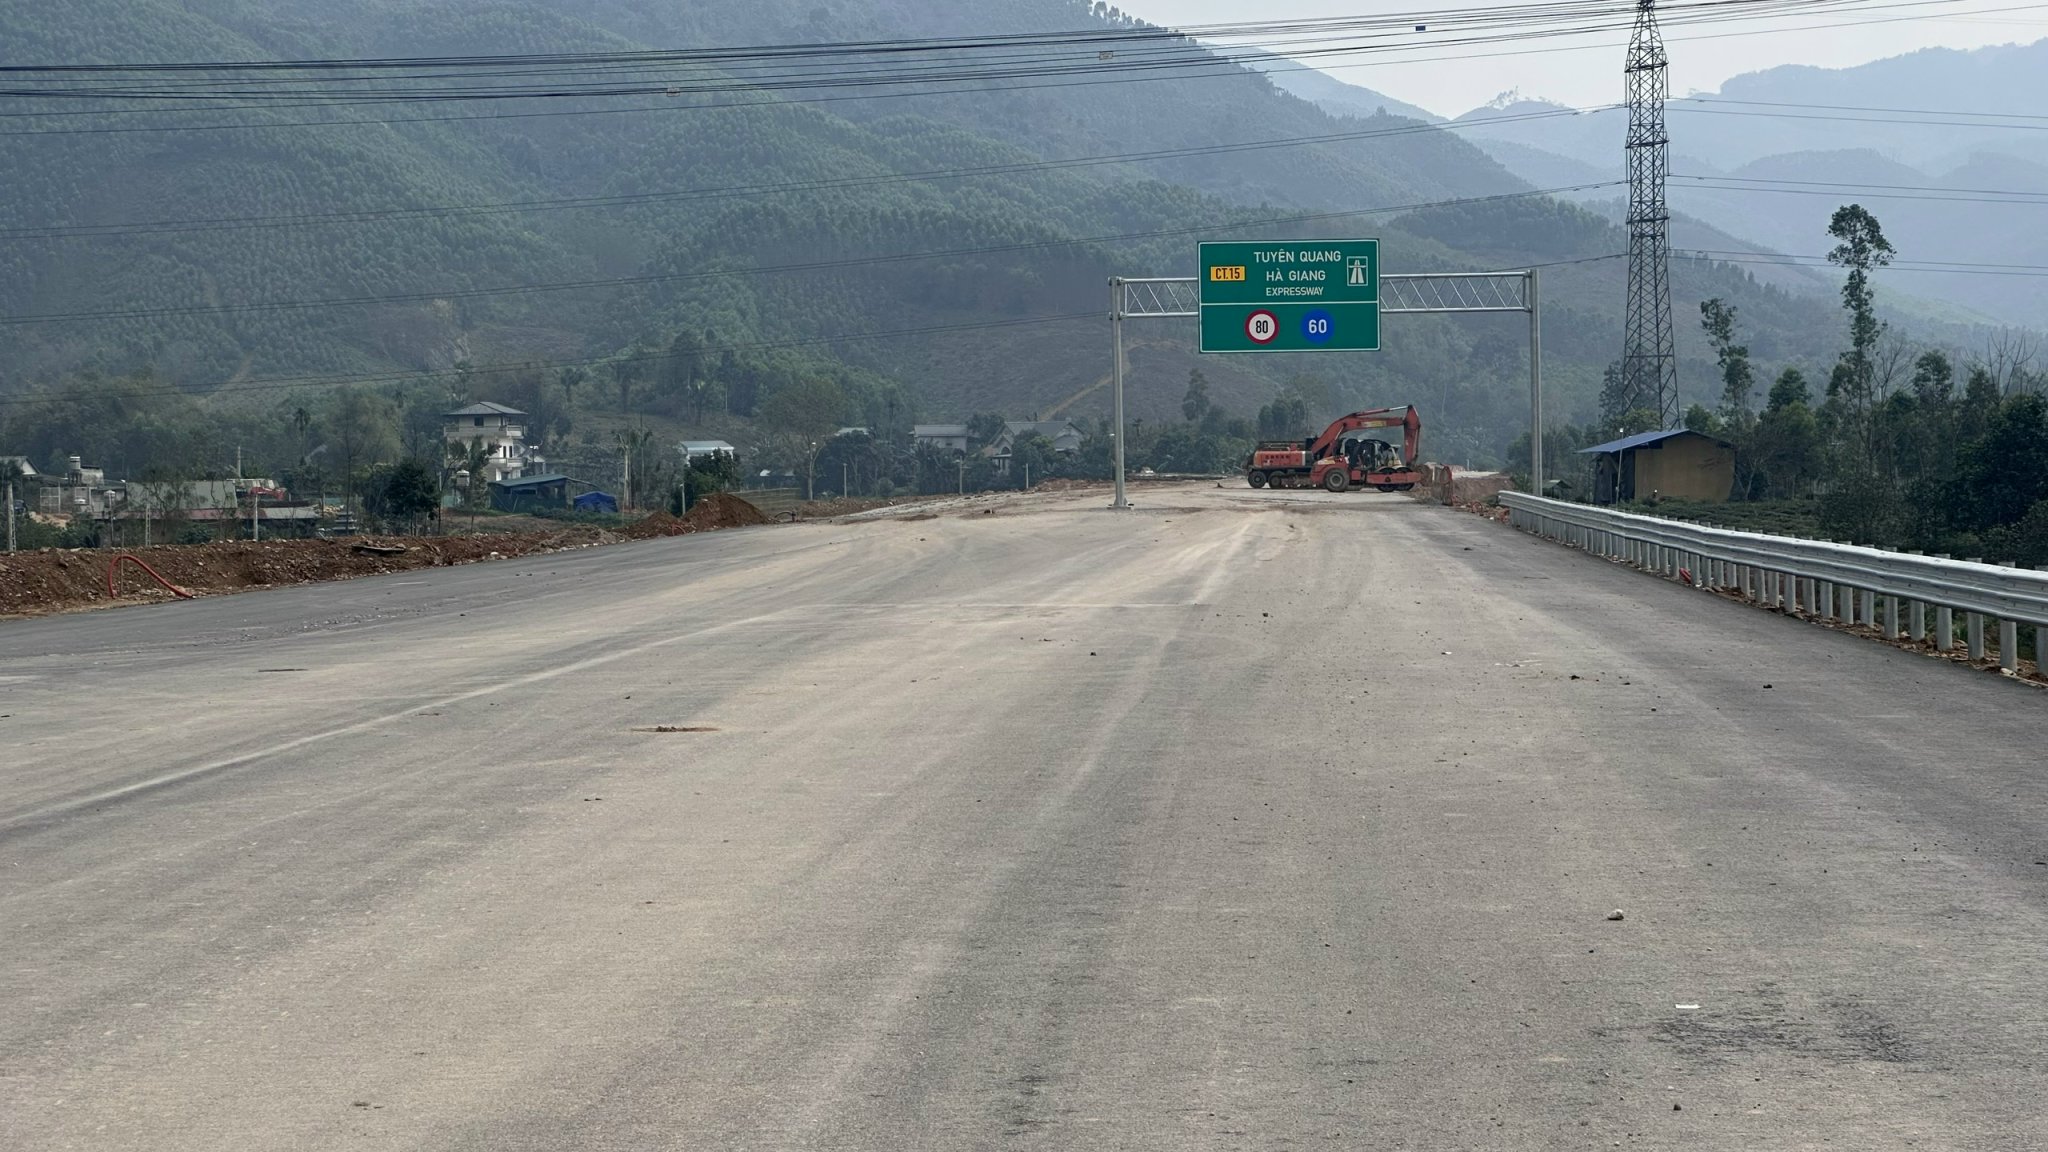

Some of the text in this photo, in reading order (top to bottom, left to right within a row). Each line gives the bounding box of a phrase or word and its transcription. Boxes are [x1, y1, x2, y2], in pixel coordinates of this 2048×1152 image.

[1253, 248, 1341, 263] TUYÊN QUANG
[1215, 267, 1240, 280] CT.15
[1266, 267, 1326, 282] HÀ GIANG
[1265, 286, 1324, 296] EXPRESSWAY
[1255, 320, 1269, 334] 80
[1308, 319, 1327, 334] 60
